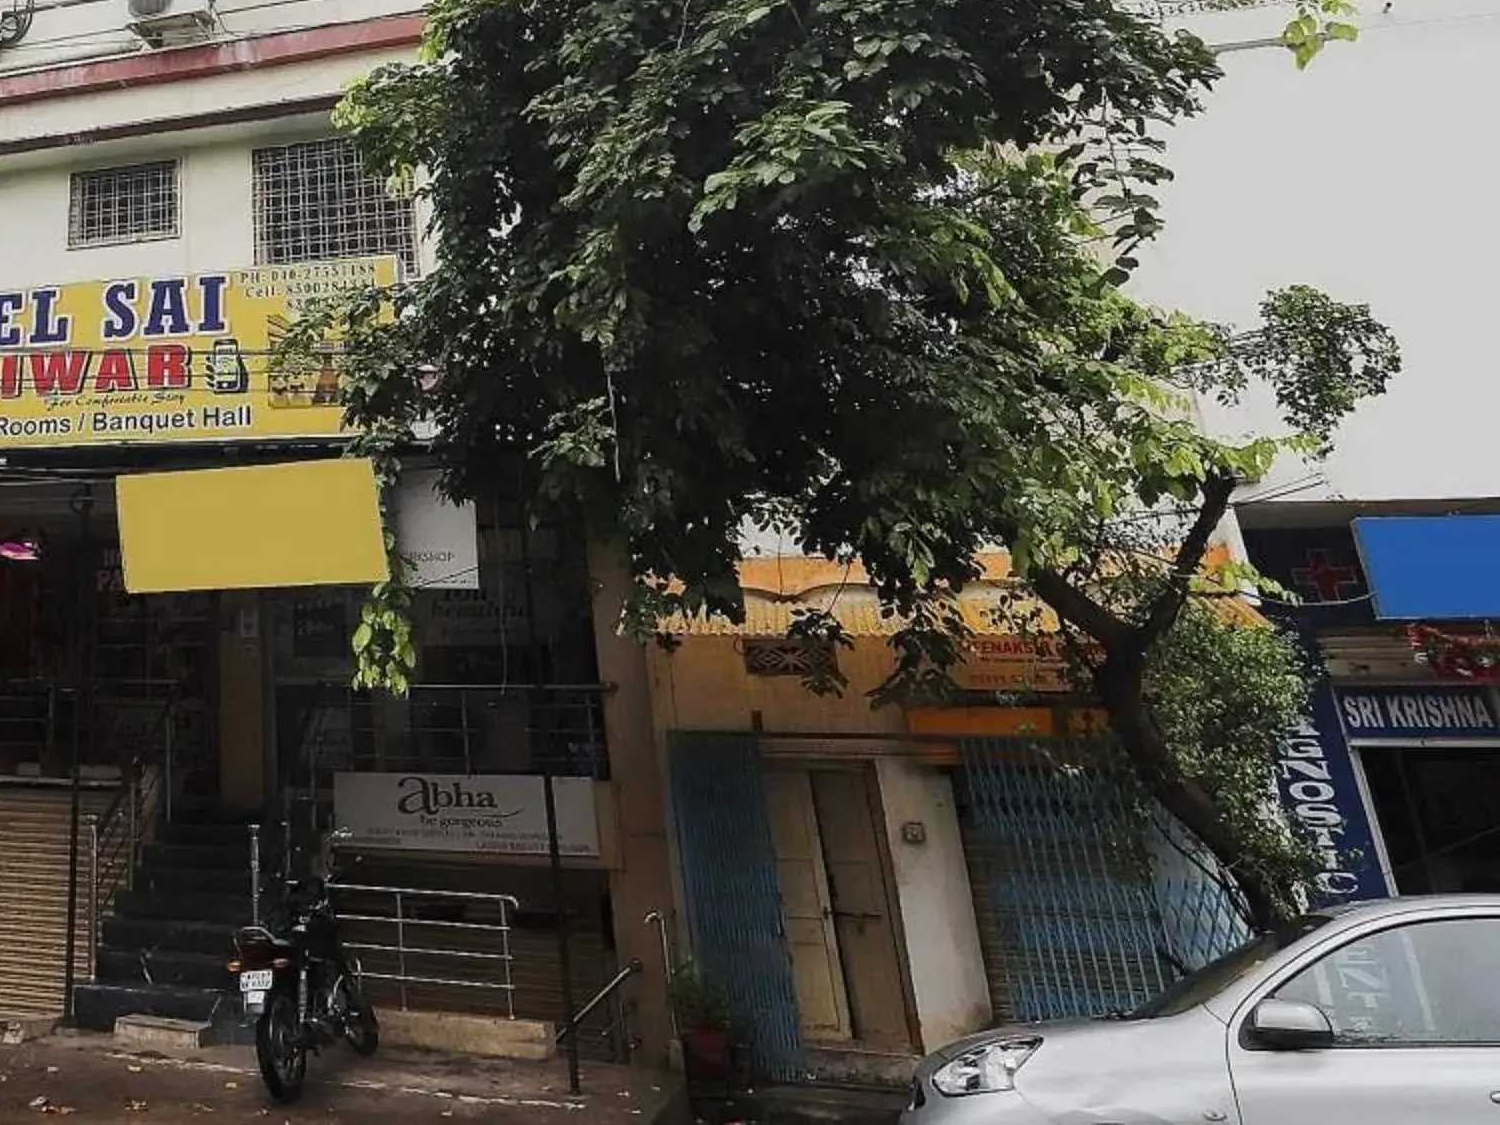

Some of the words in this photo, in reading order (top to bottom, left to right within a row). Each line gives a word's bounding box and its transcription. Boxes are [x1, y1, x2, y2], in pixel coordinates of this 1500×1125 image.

[102, 276, 227, 338] SAI
[93, 408, 196, 434] Banquet
[203, 405, 252, 427] Hall
[1343, 695, 1386, 729] SRI
[1386, 695, 1495, 729] KRISHNA
